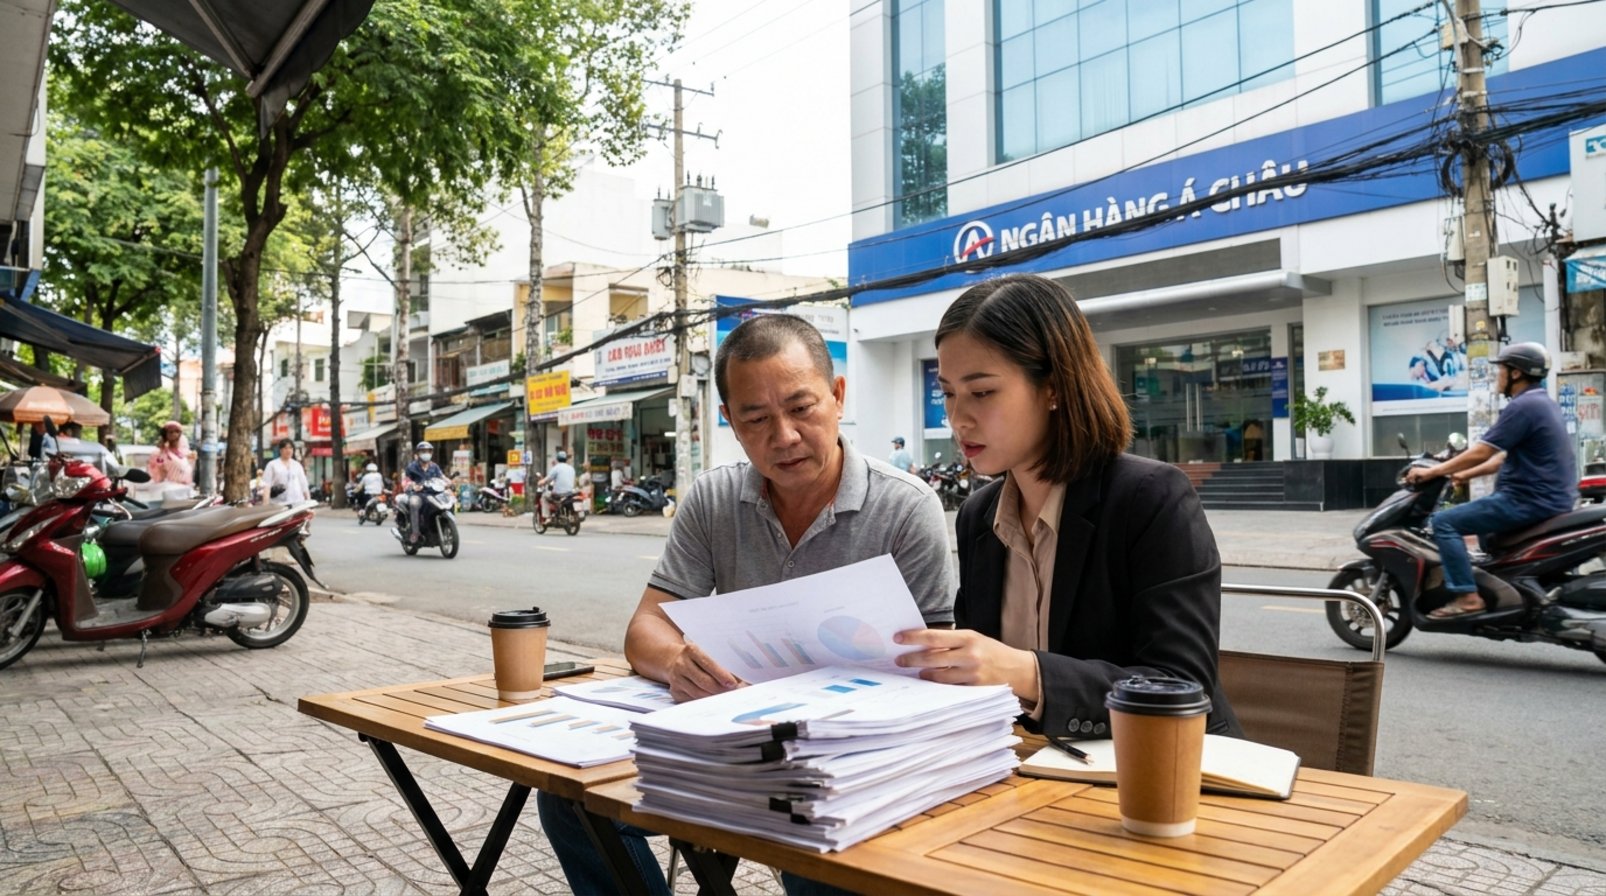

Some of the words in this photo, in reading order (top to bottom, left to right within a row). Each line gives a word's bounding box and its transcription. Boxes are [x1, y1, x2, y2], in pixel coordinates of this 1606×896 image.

[1001, 212, 1077, 252] NGÂN
[1083, 196, 1169, 233] HÀNG
[1176, 177, 1202, 221] Á
[1208, 159, 1309, 213] CHÂU
